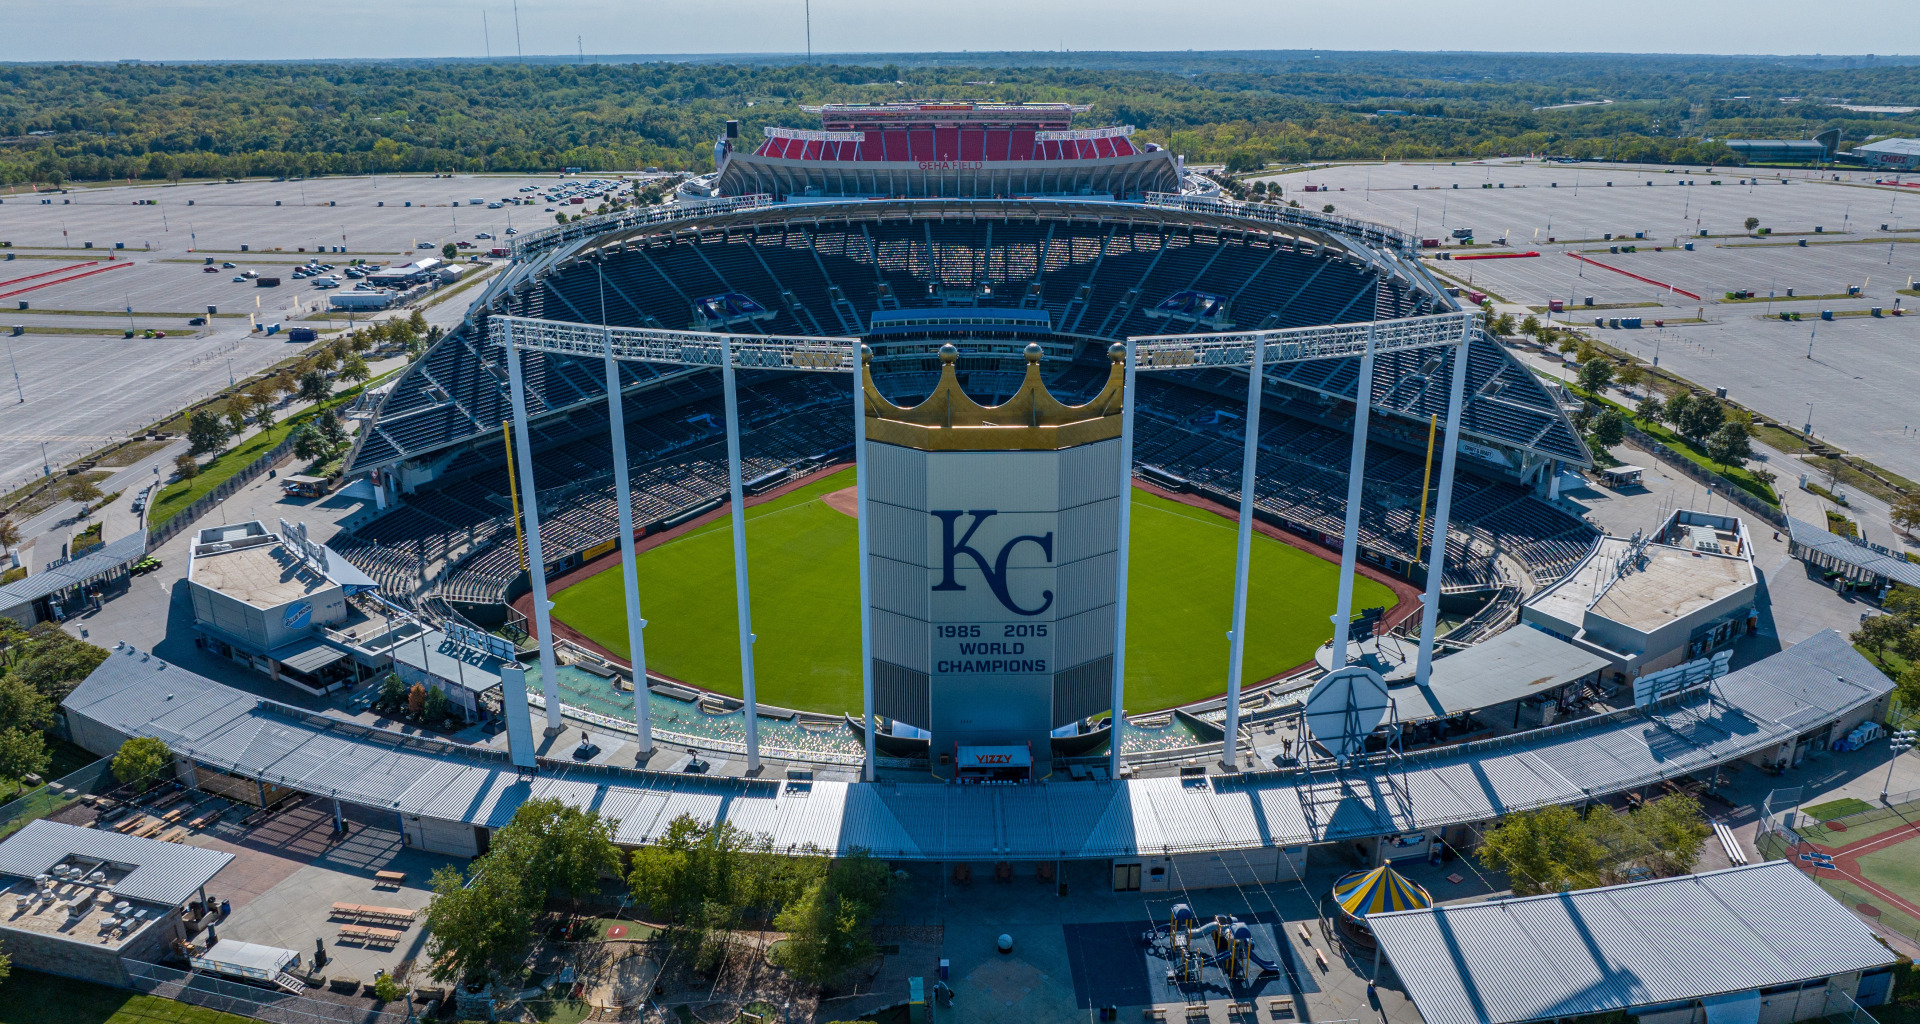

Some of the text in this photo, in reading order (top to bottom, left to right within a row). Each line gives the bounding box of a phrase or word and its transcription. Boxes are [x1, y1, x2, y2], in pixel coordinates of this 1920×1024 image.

[918, 161, 983, 170] GEHA FIELD
[1881, 154, 1907, 164] CHIEFS
[931, 509, 1053, 616] KC
[285, 604, 312, 627] BLUE MOON
[937, 625, 1048, 638] 1985 2015
[959, 642, 1025, 655] WORLD
[937, 660, 1046, 673] CHAMPIONS
[976, 754, 1012, 764] VIZZY
